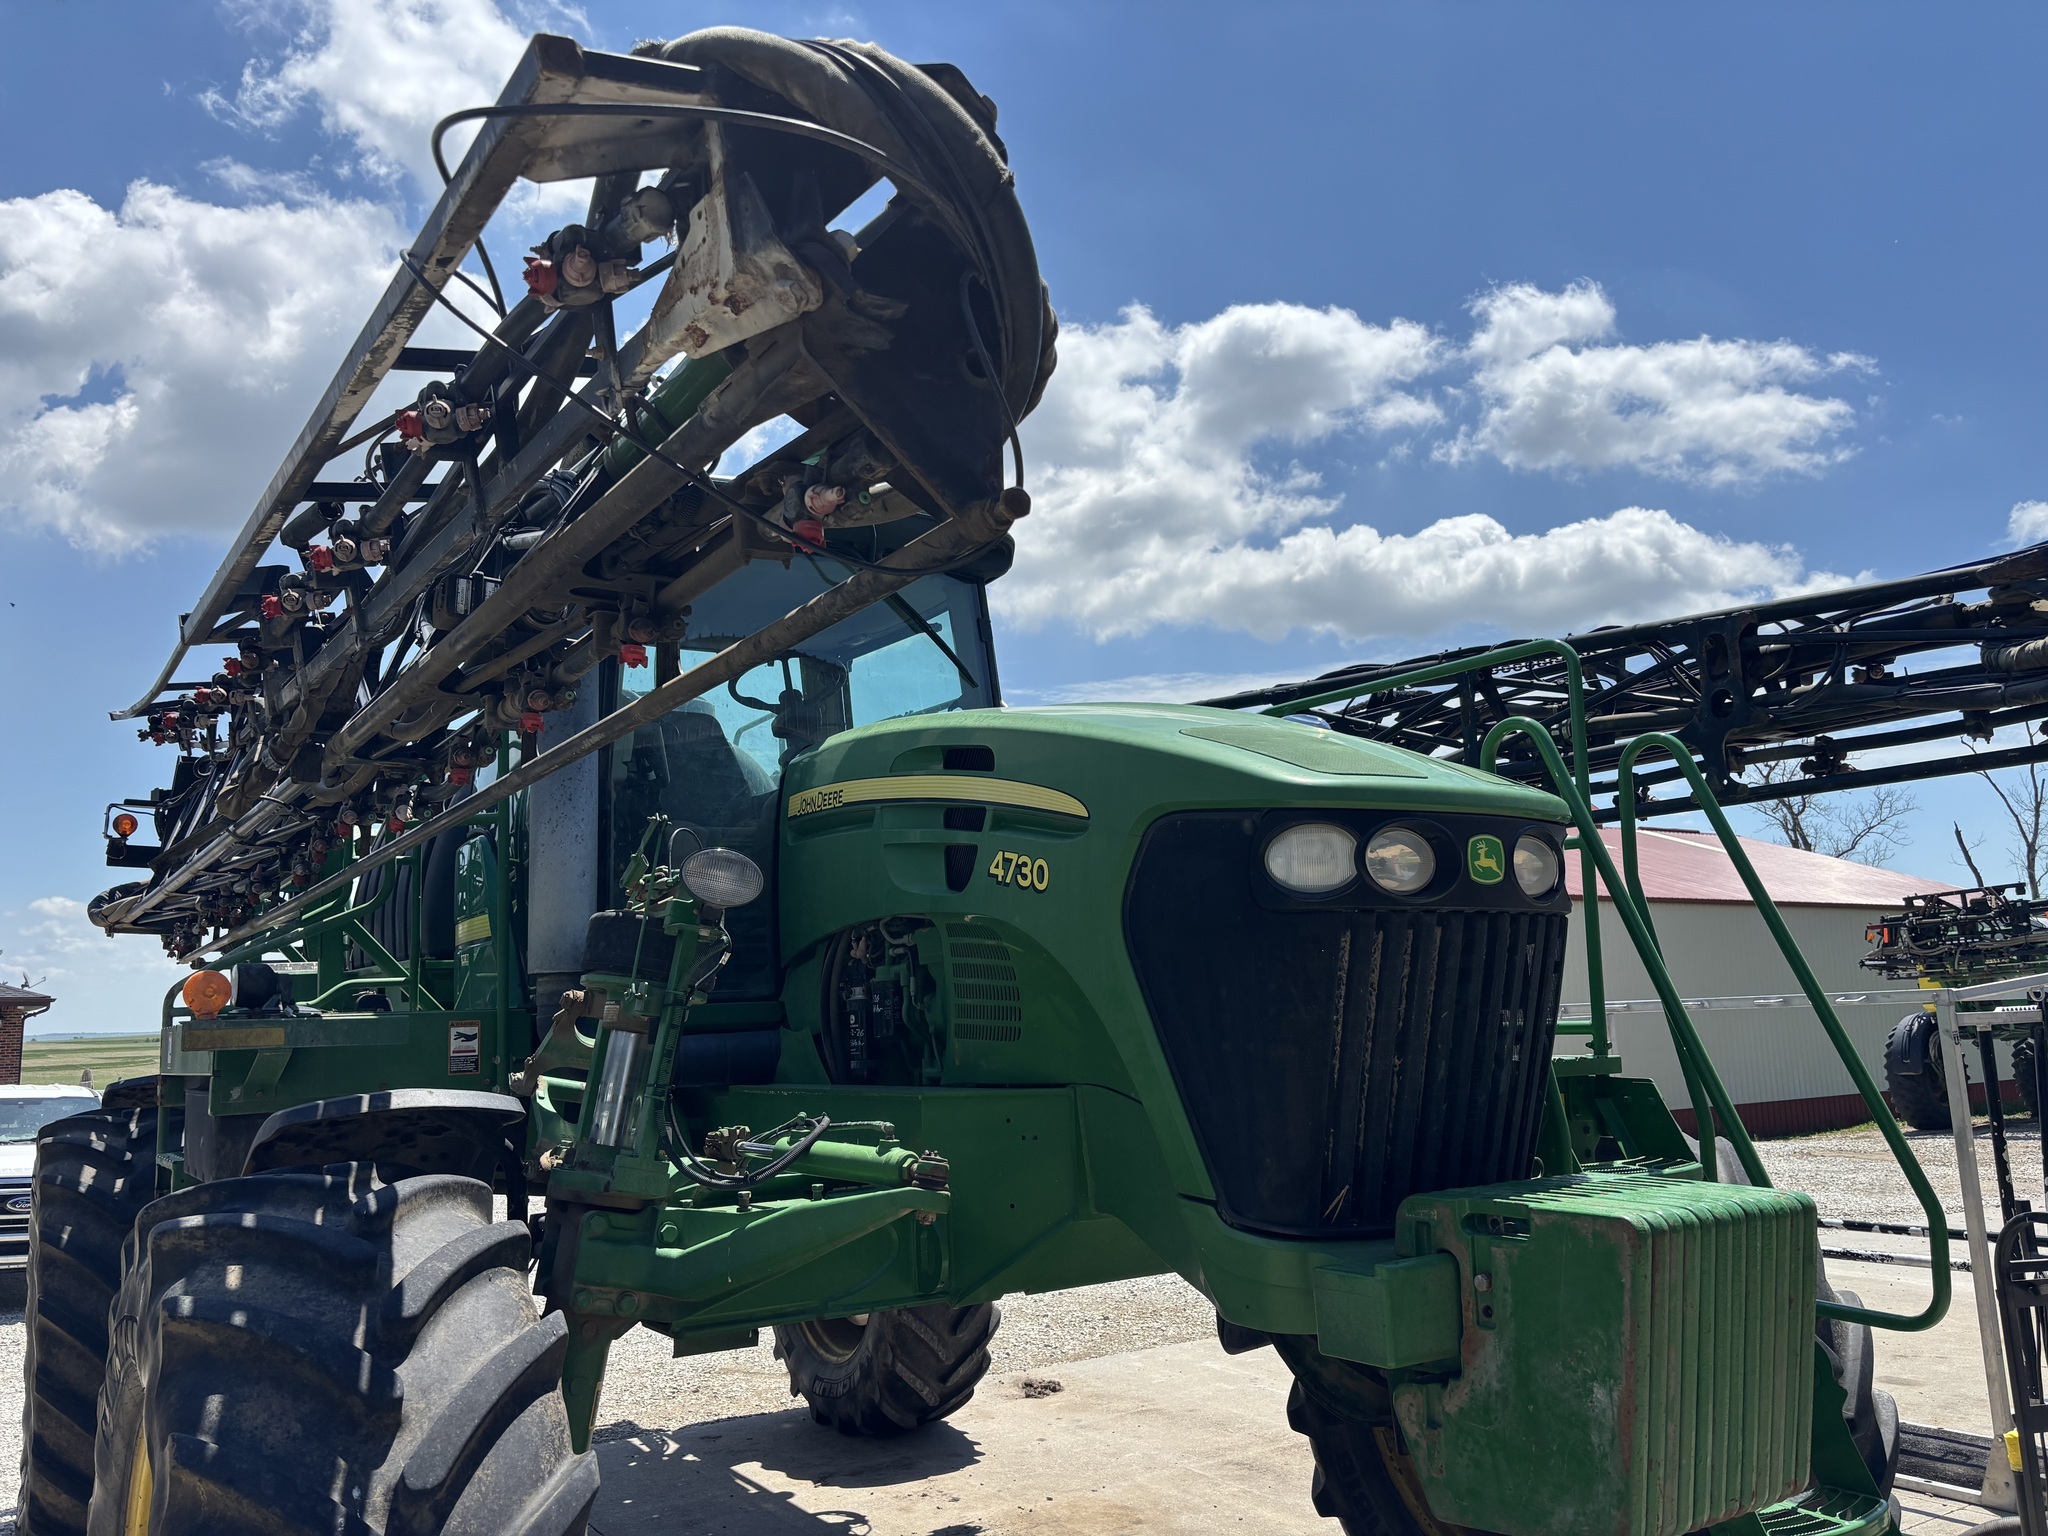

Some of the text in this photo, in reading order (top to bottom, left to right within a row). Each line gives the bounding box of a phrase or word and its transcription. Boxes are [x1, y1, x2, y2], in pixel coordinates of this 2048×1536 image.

[797, 789, 844, 814] JOHN DEERE
[988, 850, 1050, 893] 4730
[15, 1199, 31, 1208] For
